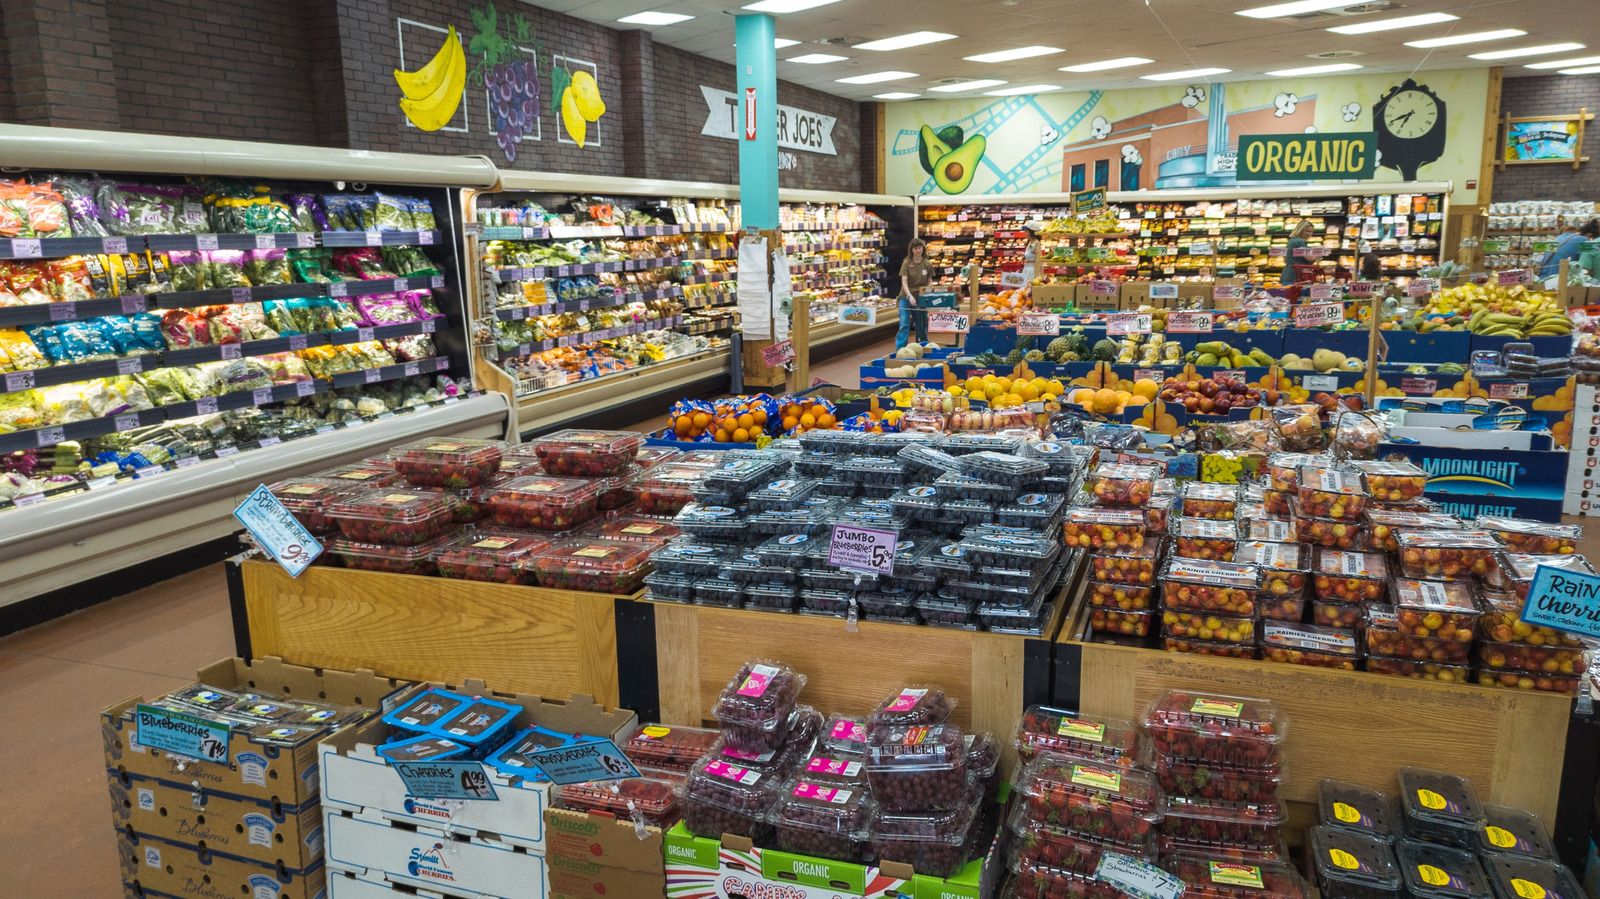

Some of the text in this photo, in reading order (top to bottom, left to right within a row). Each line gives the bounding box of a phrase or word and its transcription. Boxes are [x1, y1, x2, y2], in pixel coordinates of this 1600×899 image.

[1246, 140, 1365, 173] ORGANIC
[1352, 284, 1370, 292] KIWI
[1423, 457, 1520, 485] MOONLIGHT
[1307, 634, 1344, 644] CHERRIES
[413, 806, 451, 819] CHERRIES
[175, 818, 231, 844] Blueberries
[550, 816, 600, 834] Driscoll's
[667, 845, 697, 859] ORGANIC
[553, 855, 602, 874] Driscoll's
[793, 861, 830, 879] ORGANIC
[417, 868, 455, 882] CHERRIES
